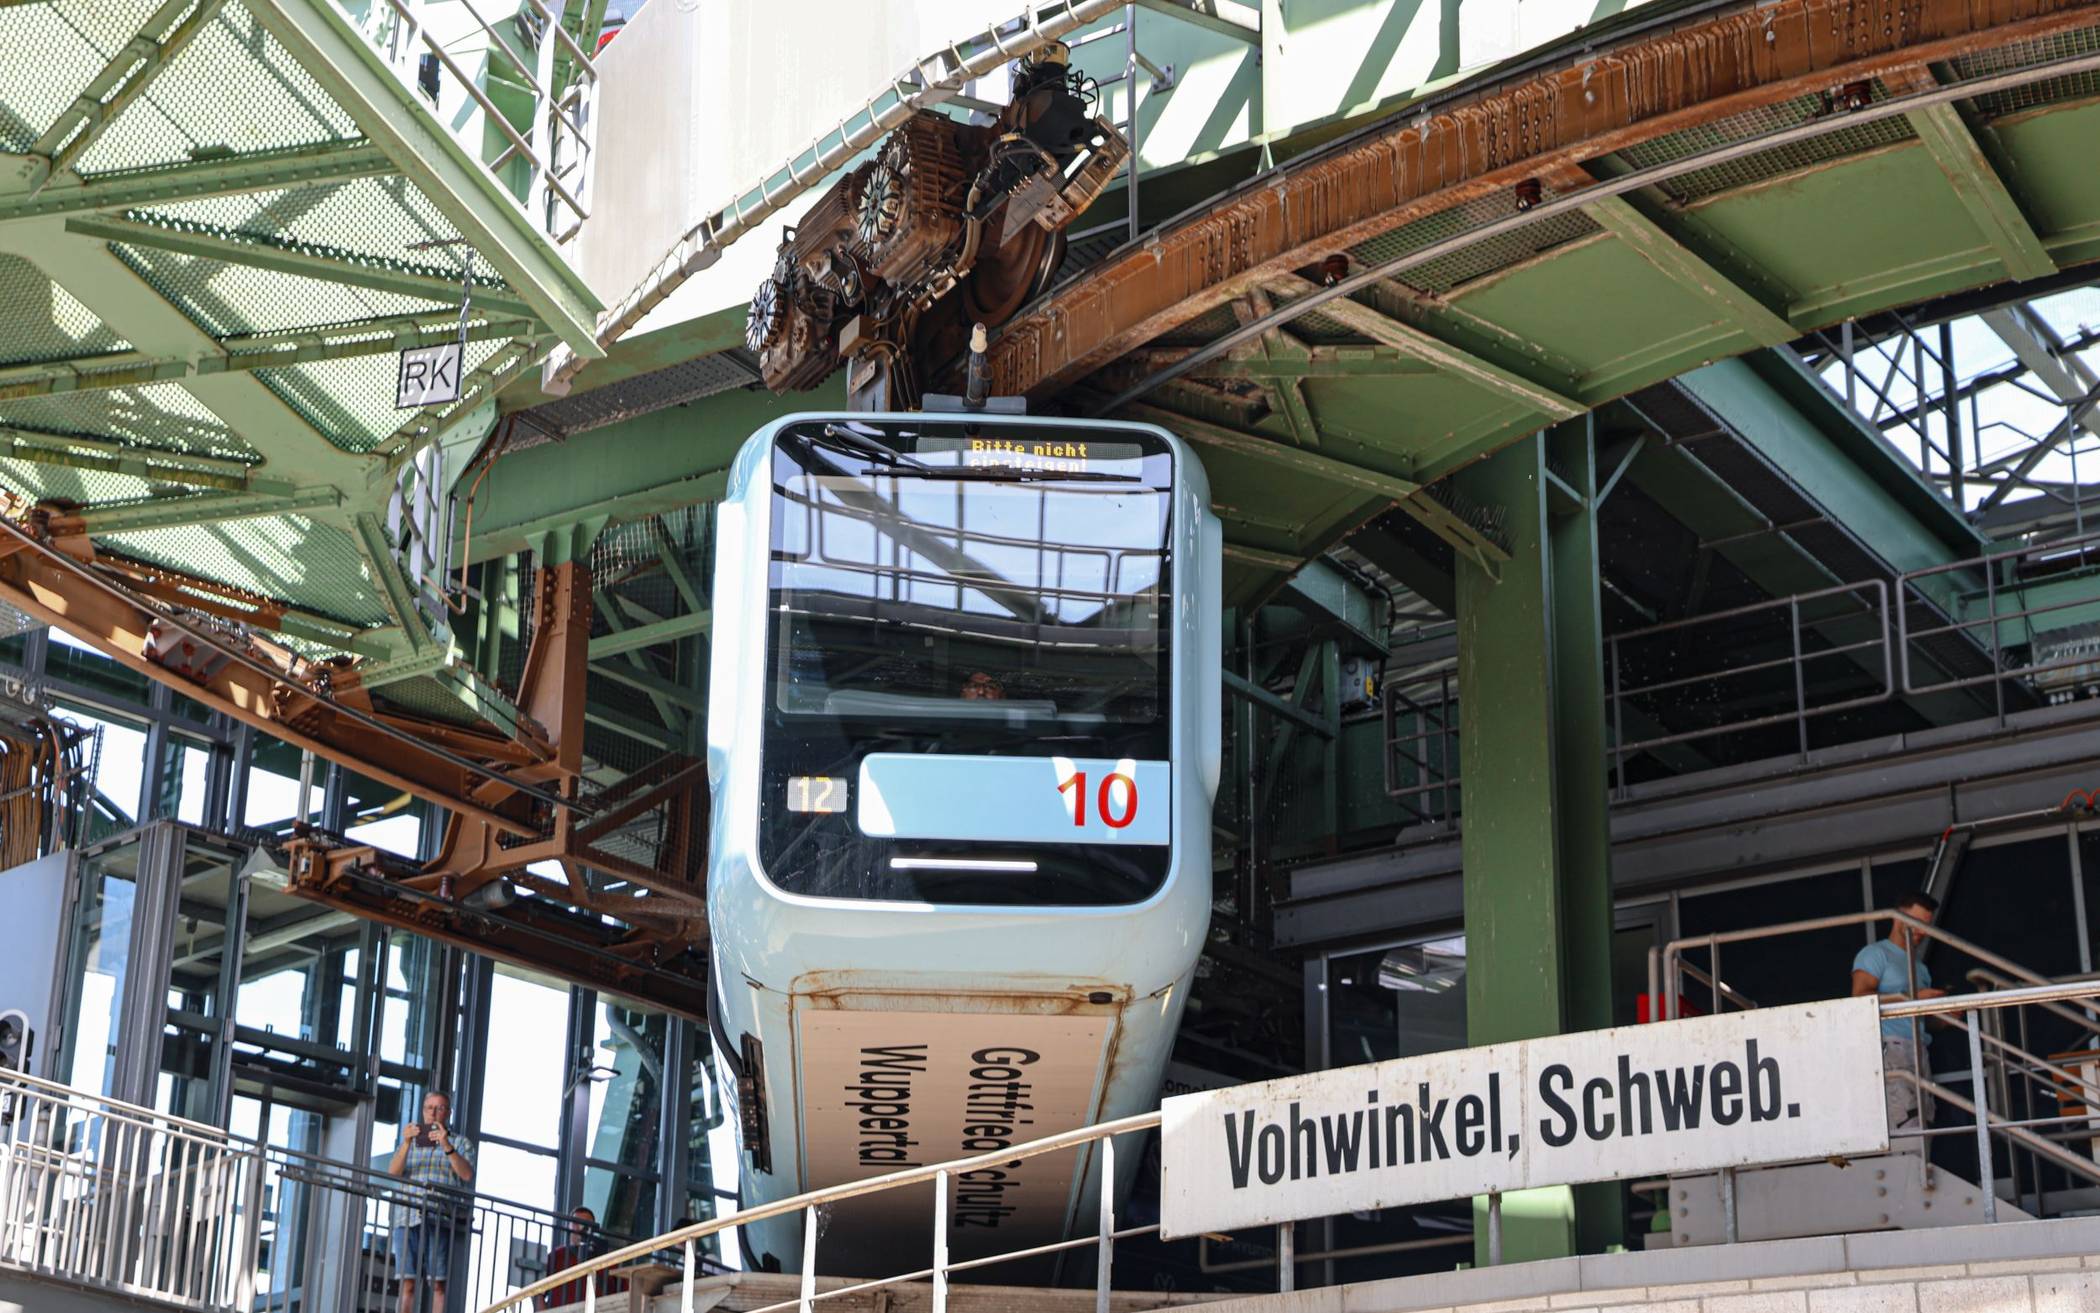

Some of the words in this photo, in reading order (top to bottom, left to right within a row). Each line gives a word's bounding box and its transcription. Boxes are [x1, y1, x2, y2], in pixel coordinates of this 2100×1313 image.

[404, 356, 453, 394] RK
[972, 439, 1025, 455] Bitte
[1034, 442, 1087, 457] nicht
[797, 775, 833, 814] 12
[1056, 771, 1139, 829] 10
[844, 1044, 928, 1167] Wuppertal
[1224, 1072, 1520, 1190] Vohwinkel,
[1539, 1038, 1801, 1148] Schweb.
[954, 1159, 1024, 1228] chultz
